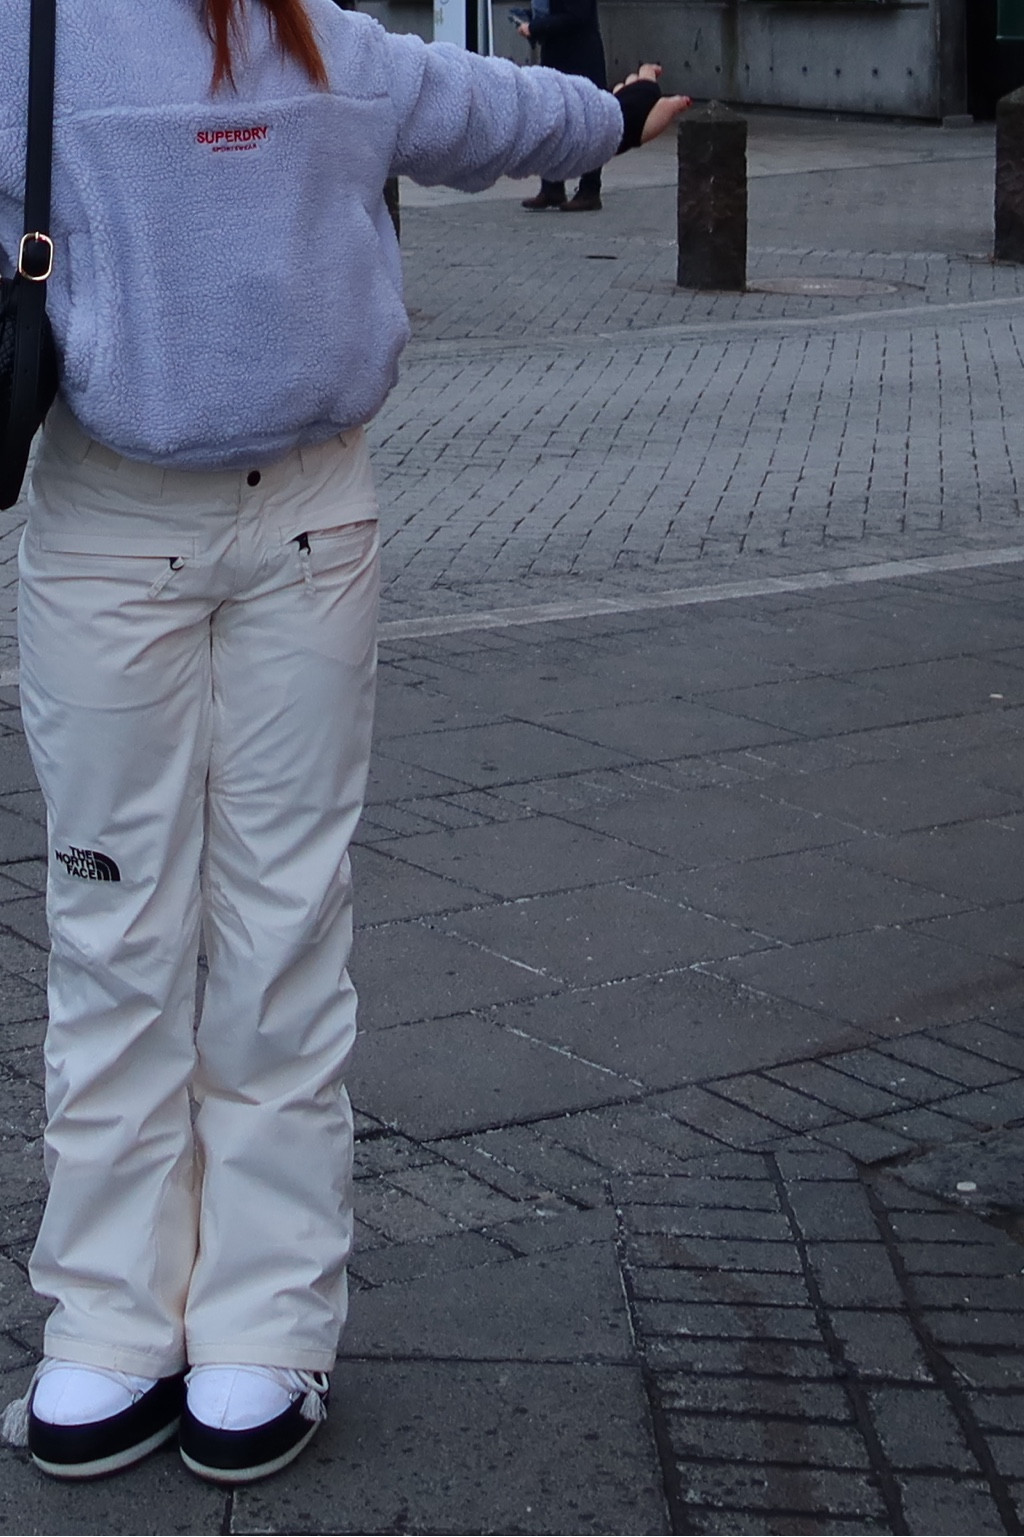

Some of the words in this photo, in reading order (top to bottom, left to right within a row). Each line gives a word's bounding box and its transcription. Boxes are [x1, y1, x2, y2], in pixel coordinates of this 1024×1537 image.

[196, 126, 268, 144] SUPERDRY
[55, 849, 96, 869] NORTH
[68, 845, 93, 861] THE
[66, 864, 97, 880] FACE
